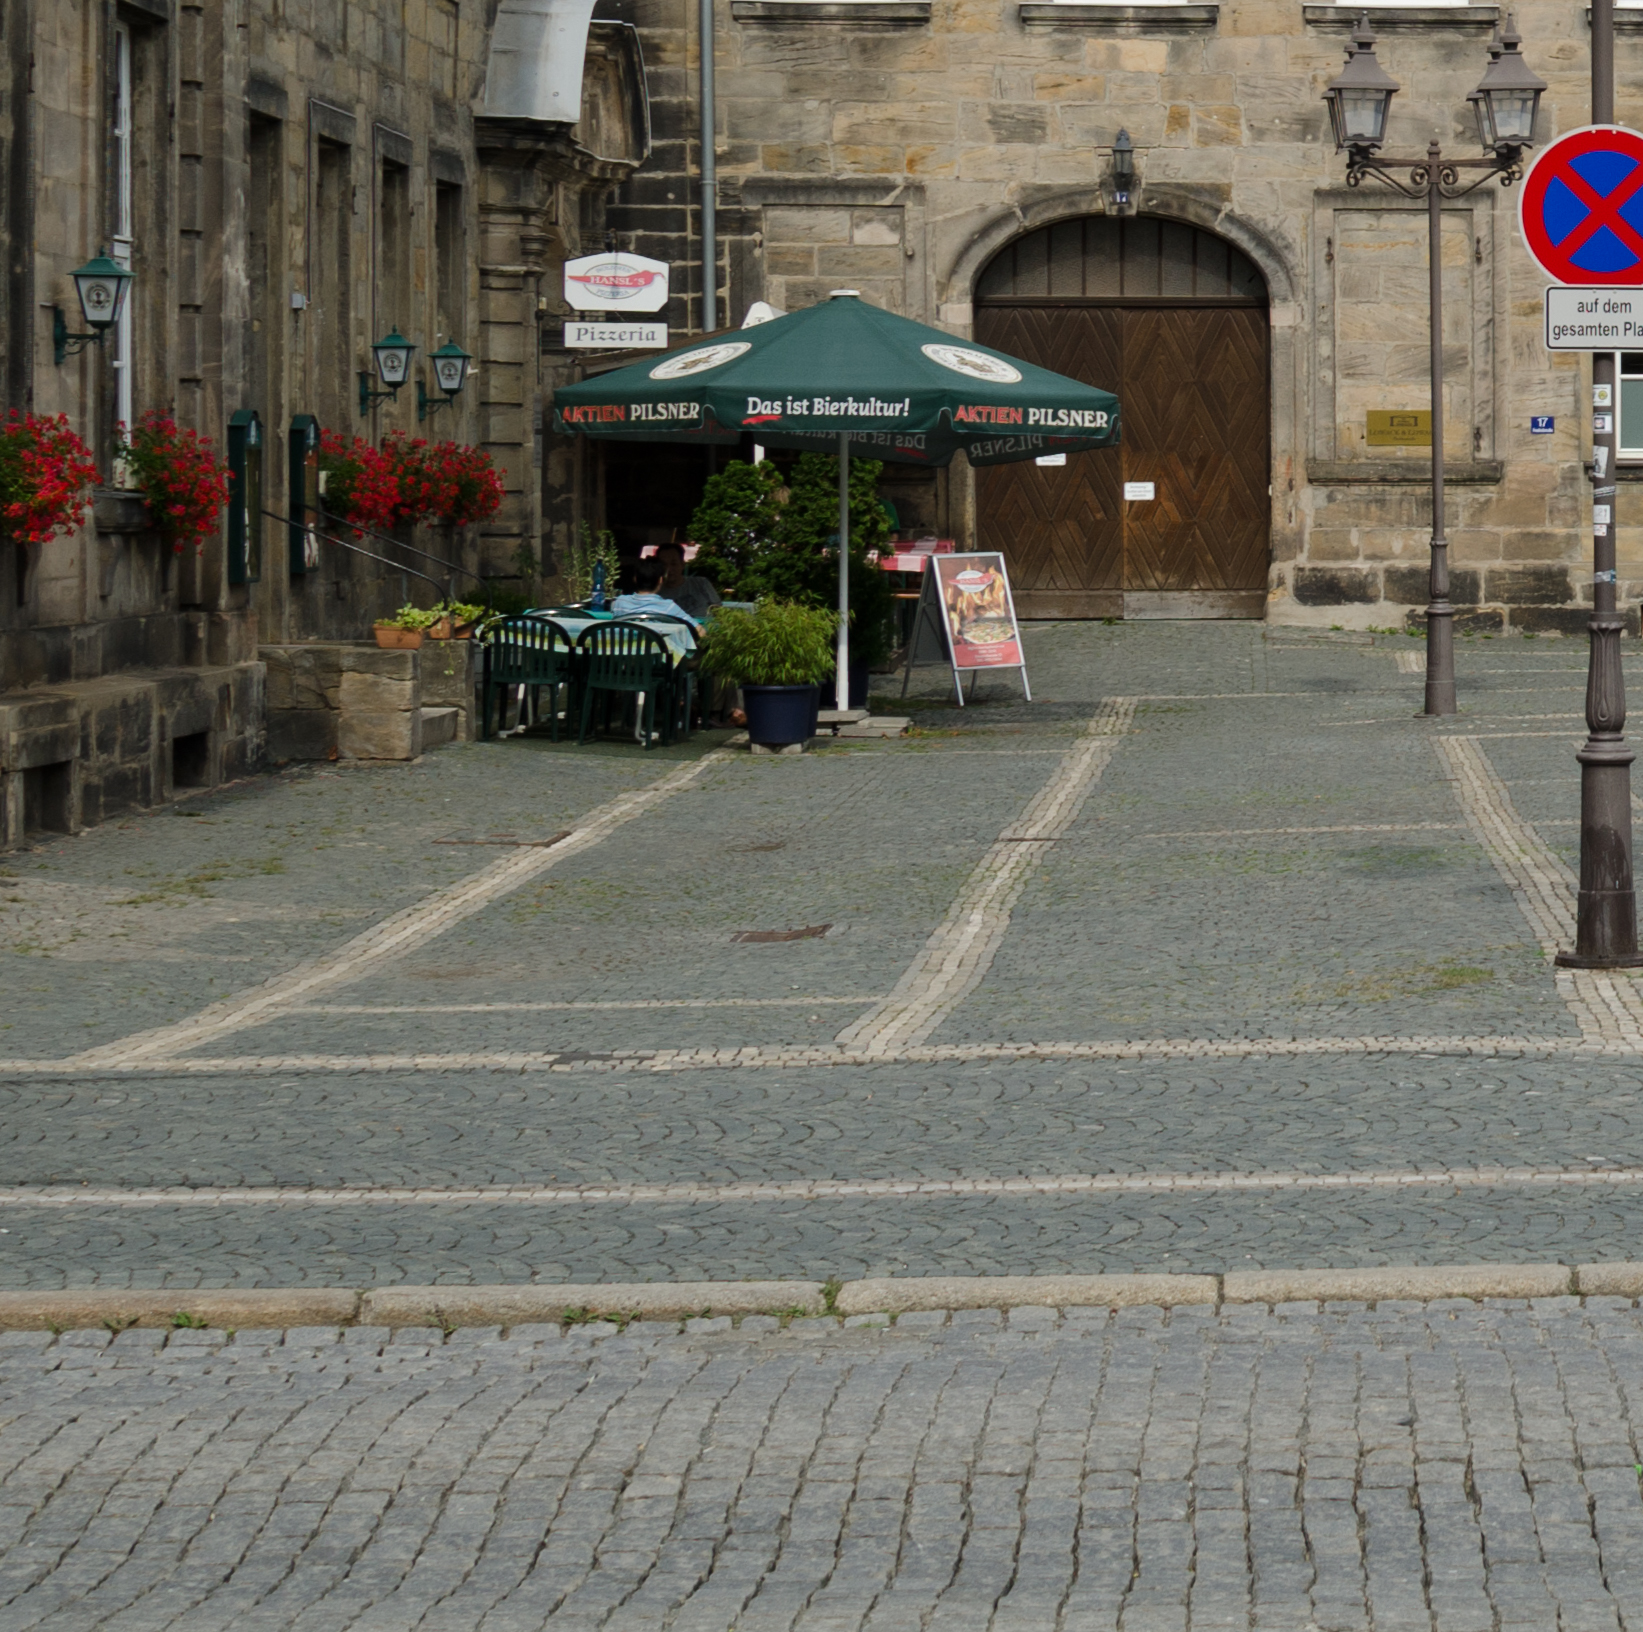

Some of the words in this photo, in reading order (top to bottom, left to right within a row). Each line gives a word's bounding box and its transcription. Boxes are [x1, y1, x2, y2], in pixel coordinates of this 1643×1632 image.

[1577, 298, 1599, 313] auf
[1603, 298, 1632, 313] dem
[575, 326, 658, 342] Pizzeria
[1553, 323, 1619, 340] gesamten
[561, 404, 626, 424] AKTIEN
[630, 402, 701, 421] PILSNER
[746, 396, 783, 416] Das
[786, 395, 809, 416] ist
[812, 396, 911, 417] Bierkultur!
[954, 404, 1023, 424] AKTIEN
[1027, 407, 1109, 428] PILSNER
[1536, 417, 1550, 428] 17
